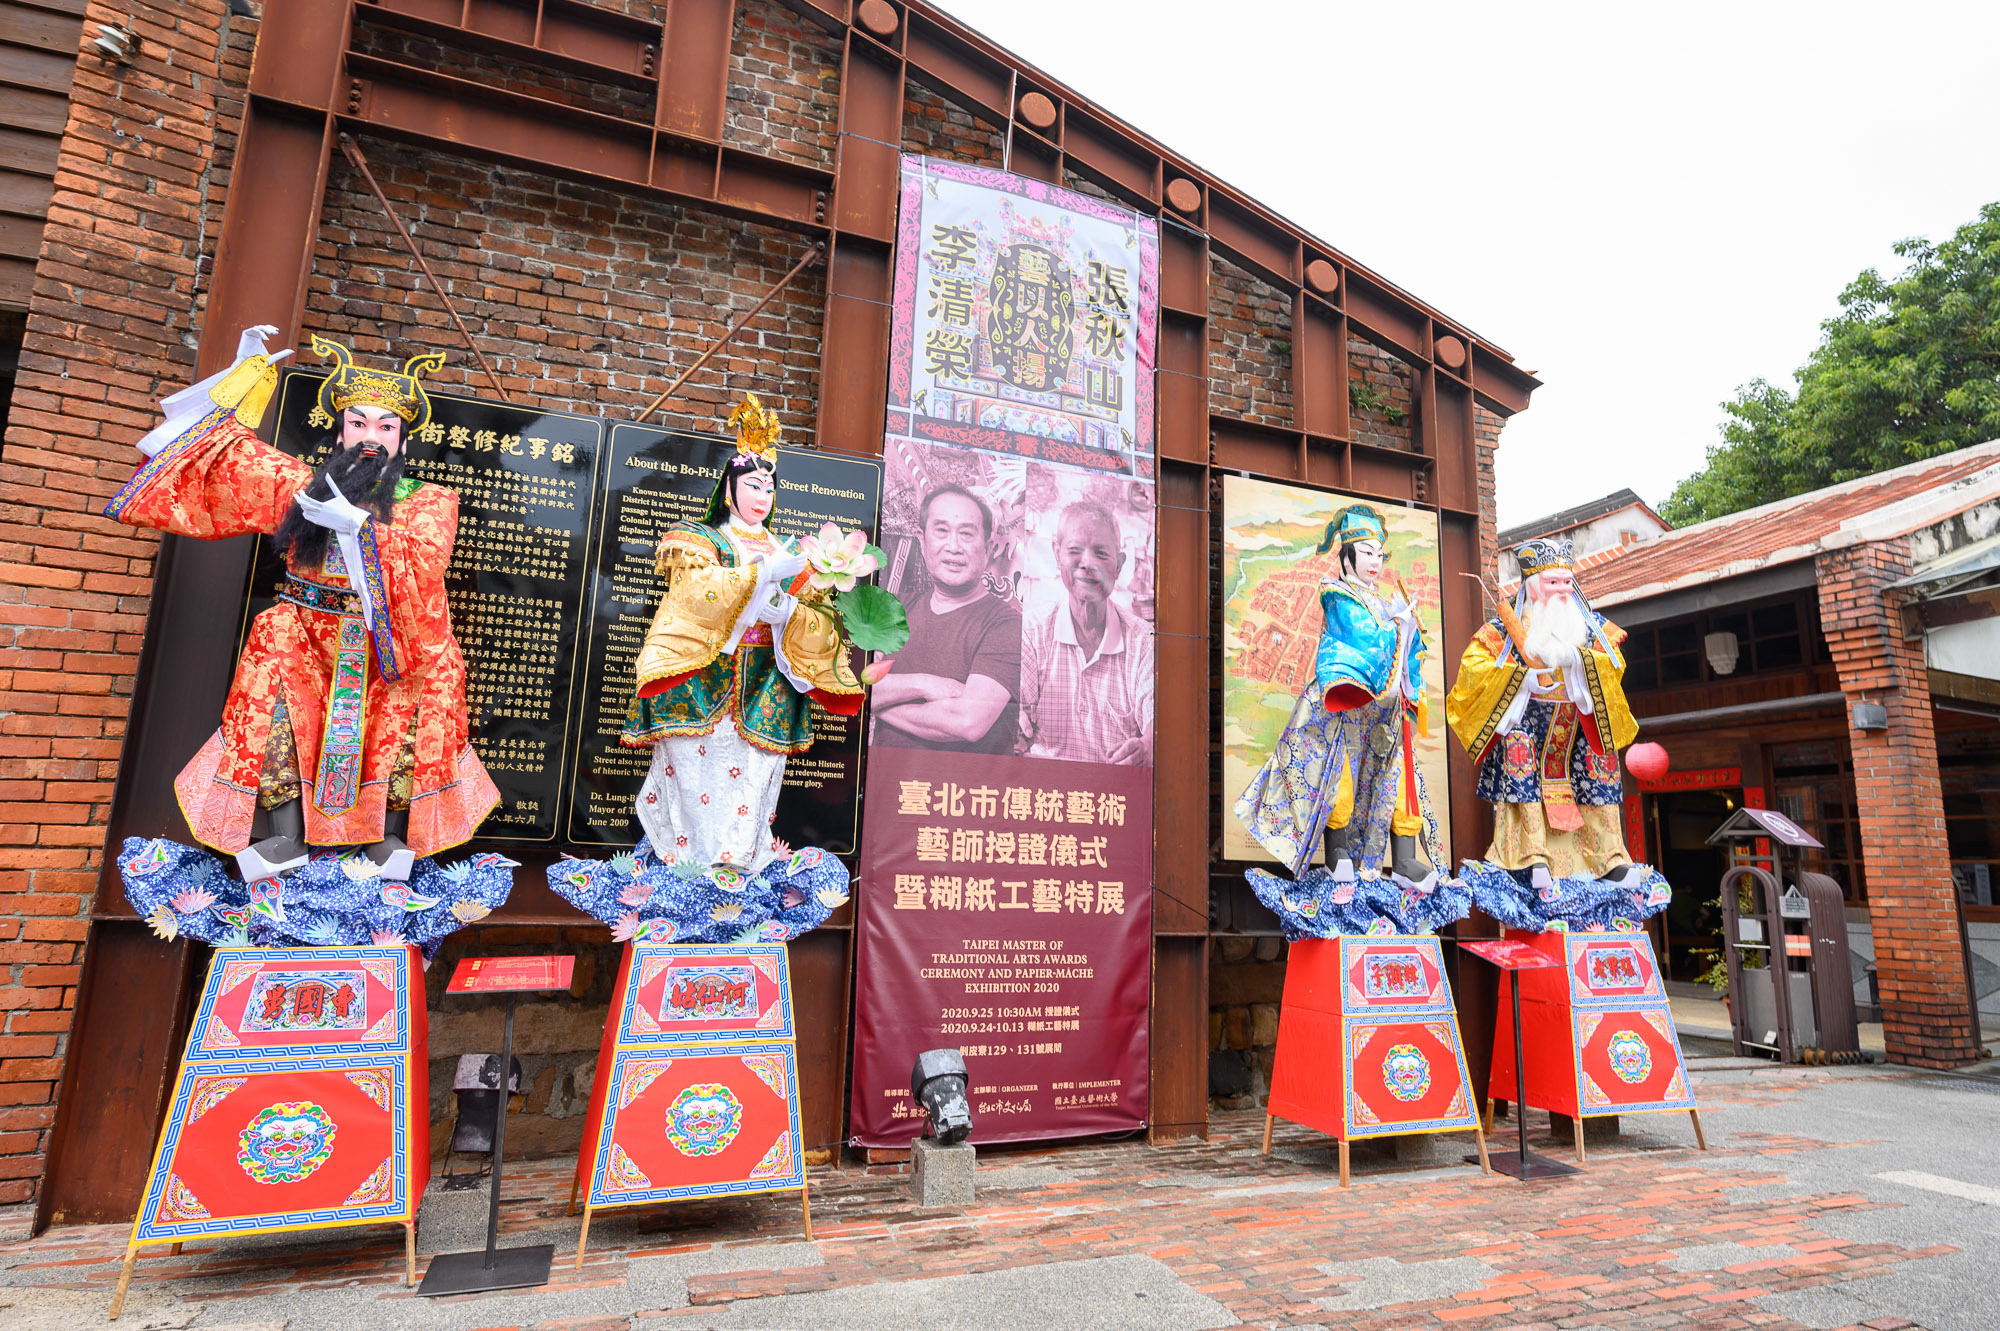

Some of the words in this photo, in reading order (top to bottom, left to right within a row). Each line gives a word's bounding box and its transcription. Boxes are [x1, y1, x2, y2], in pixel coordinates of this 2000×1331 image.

[925, 224, 978, 380] 李清榮
[1013, 247, 1052, 388] 藝以人揚
[1084, 260, 1128, 411] 張秋山
[408, 422, 575, 464] 街整修紀事銘
[449, 464, 464, 473] 173
[625, 456, 658, 470] About
[661, 462, 678, 473] the
[779, 479, 809, 493] Street
[811, 483, 865, 501] Renovation
[458, 498, 535, 515] ，成為後街小巷。
[633, 486, 658, 497] Known
[659, 491, 679, 501] today
[688, 494, 706, 504] Lane
[808, 511, 828, 521] Street
[828, 513, 836, 521] in
[621, 506, 649, 517] passage
[650, 508, 680, 520] between
[622, 495, 651, 507] District
[651, 499, 658, 507] is
[782, 518, 803, 527] which
[803, 521, 819, 529] used
[620, 515, 652, 526] Colonial
[618, 525, 654, 536] displaced
[617, 536, 654, 548] relegating
[454, 538, 569, 559] 此久已疏離的社會關係，在
[625, 554, 657, 567] Entering
[614, 563, 632, 573] lives
[613, 574, 626, 582] old
[629, 577, 654, 586] streets
[612, 585, 645, 594] relations
[611, 594, 621, 602] of
[620, 595, 644, 605] Taipei
[608, 624, 643, 634] residents,
[608, 632, 641, 644] Yu-chien
[605, 653, 623, 662] from
[465, 671, 551, 685] 中市府召集教育局、
[600, 696, 617, 704] care
[618, 696, 627, 704] in
[823, 714, 848, 723] various
[816, 733, 828, 741] the
[827, 735, 847, 743] many
[604, 745, 633, 755] Besides
[785, 758, 818, 767] o-Pi-Liao
[818, 760, 846, 769] Historic
[592, 766, 602, 774] of
[602, 767, 631, 776] historic
[593, 756, 617, 765] Street
[617, 757, 633, 765] also
[794, 769, 845, 780] redevelopment
[590, 791, 603, 801] Dr.
[897, 779, 1127, 826] 臺北市傳統藝術
[588, 804, 615, 815] Mayor
[617, 806, 627, 815] of
[487, 814, 537, 825] 八年六月
[586, 817, 608, 827] June
[609, 818, 630, 827] 2009
[916, 826, 1108, 869] 藝師授證儀式
[893, 874, 1126, 915] 暨糊紙工藝特展
[962, 939, 1000, 951] TAIPEI
[1002, 940, 1047, 951] MASTER
[1049, 940, 1064, 951] OF
[931, 953, 1010, 964] TRADITIONAL
[1012, 954, 1041, 965] ARTS
[1042, 954, 1088, 965] AWARDS
[920, 968, 986, 979] CEREMONY
[987, 968, 1013, 979] AND
[964, 983, 1031, 994] EXHIBITION
[1033, 982, 1060, 993] 2020
[941, 1007, 994, 1019] 2020.9.25
[997, 1007, 1042, 1018] 10:30AM
[1044, 1006, 1080, 1017] 授證儀式
[1001, 1084, 1039, 1093] ORGANIZER
[1078, 1079, 1122, 1089] IMPLEMENTER
[909, 1107, 931, 1118] 臺北
[1054, 1091, 1119, 1106] 國立臺北藝術大學
